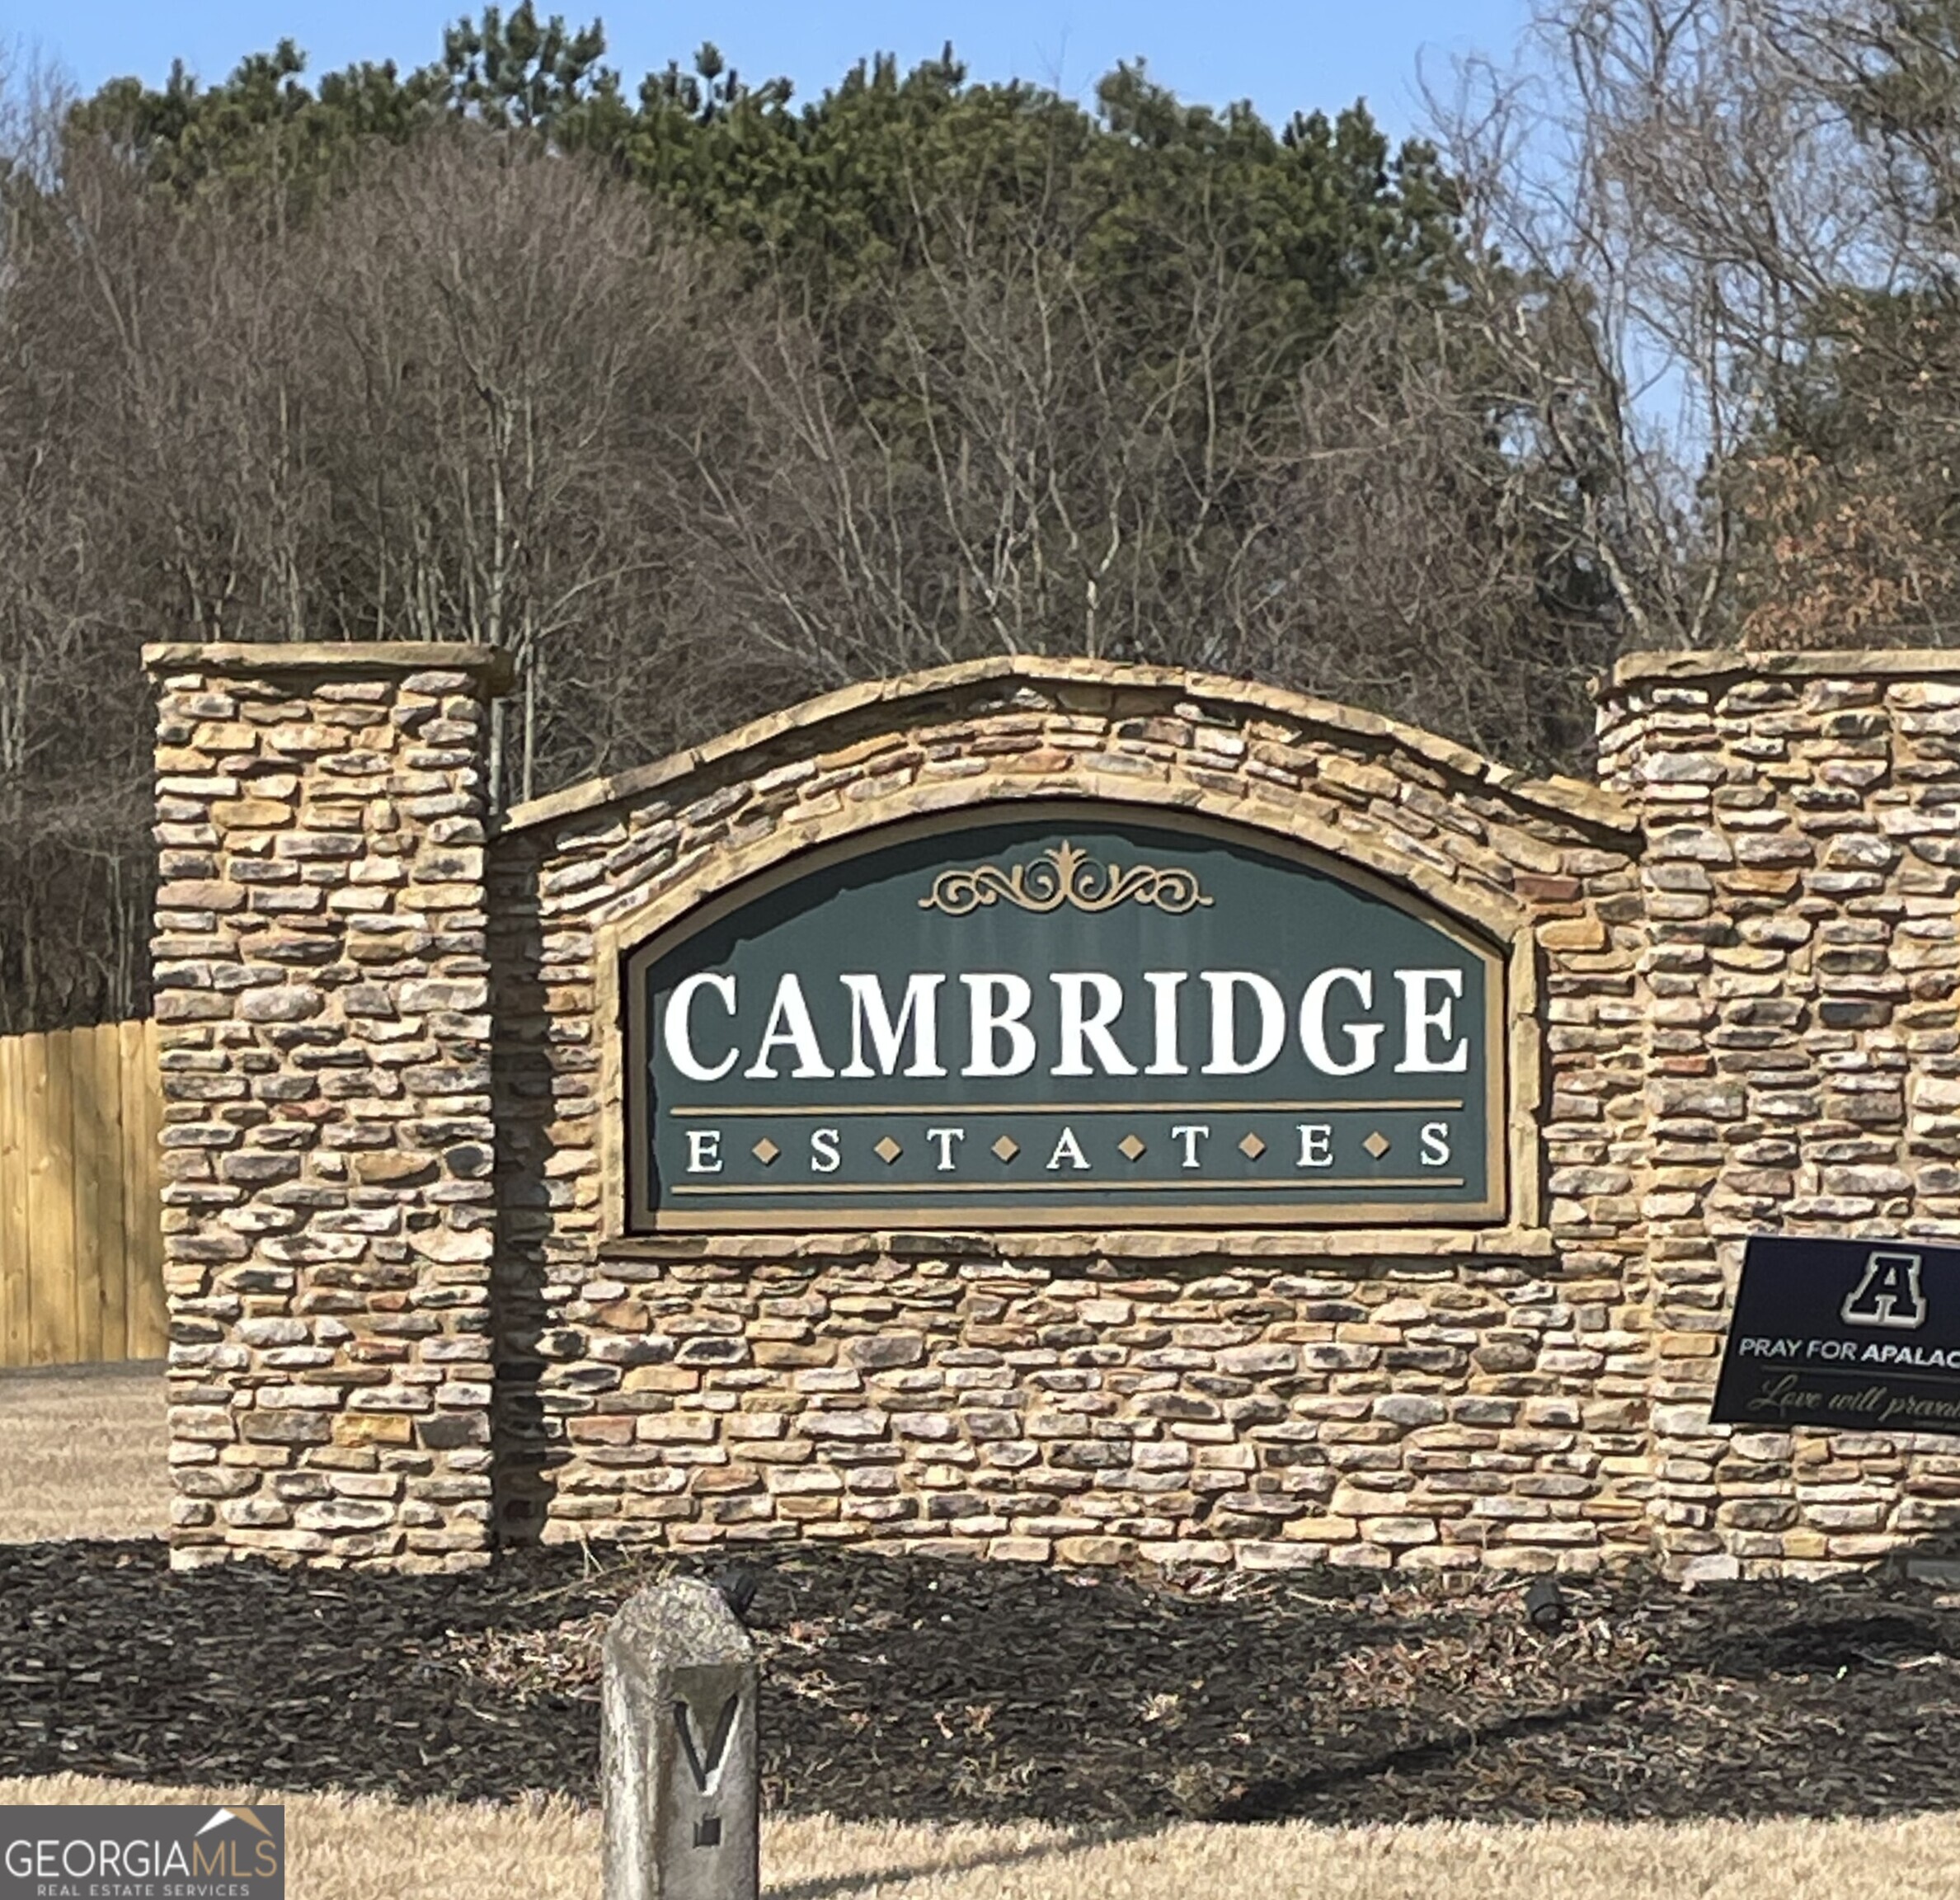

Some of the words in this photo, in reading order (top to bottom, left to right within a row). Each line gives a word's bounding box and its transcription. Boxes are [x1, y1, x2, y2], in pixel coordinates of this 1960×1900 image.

[663, 967, 1469, 1082] CAMBRIDGE
[1840, 1250, 1926, 1329] A
[1738, 1337, 1802, 1357] PRAY
[1806, 1339, 1857, 1361] FOR
[1746, 1374, 1821, 1411] Love
[1827, 1386, 1887, 1412] will
